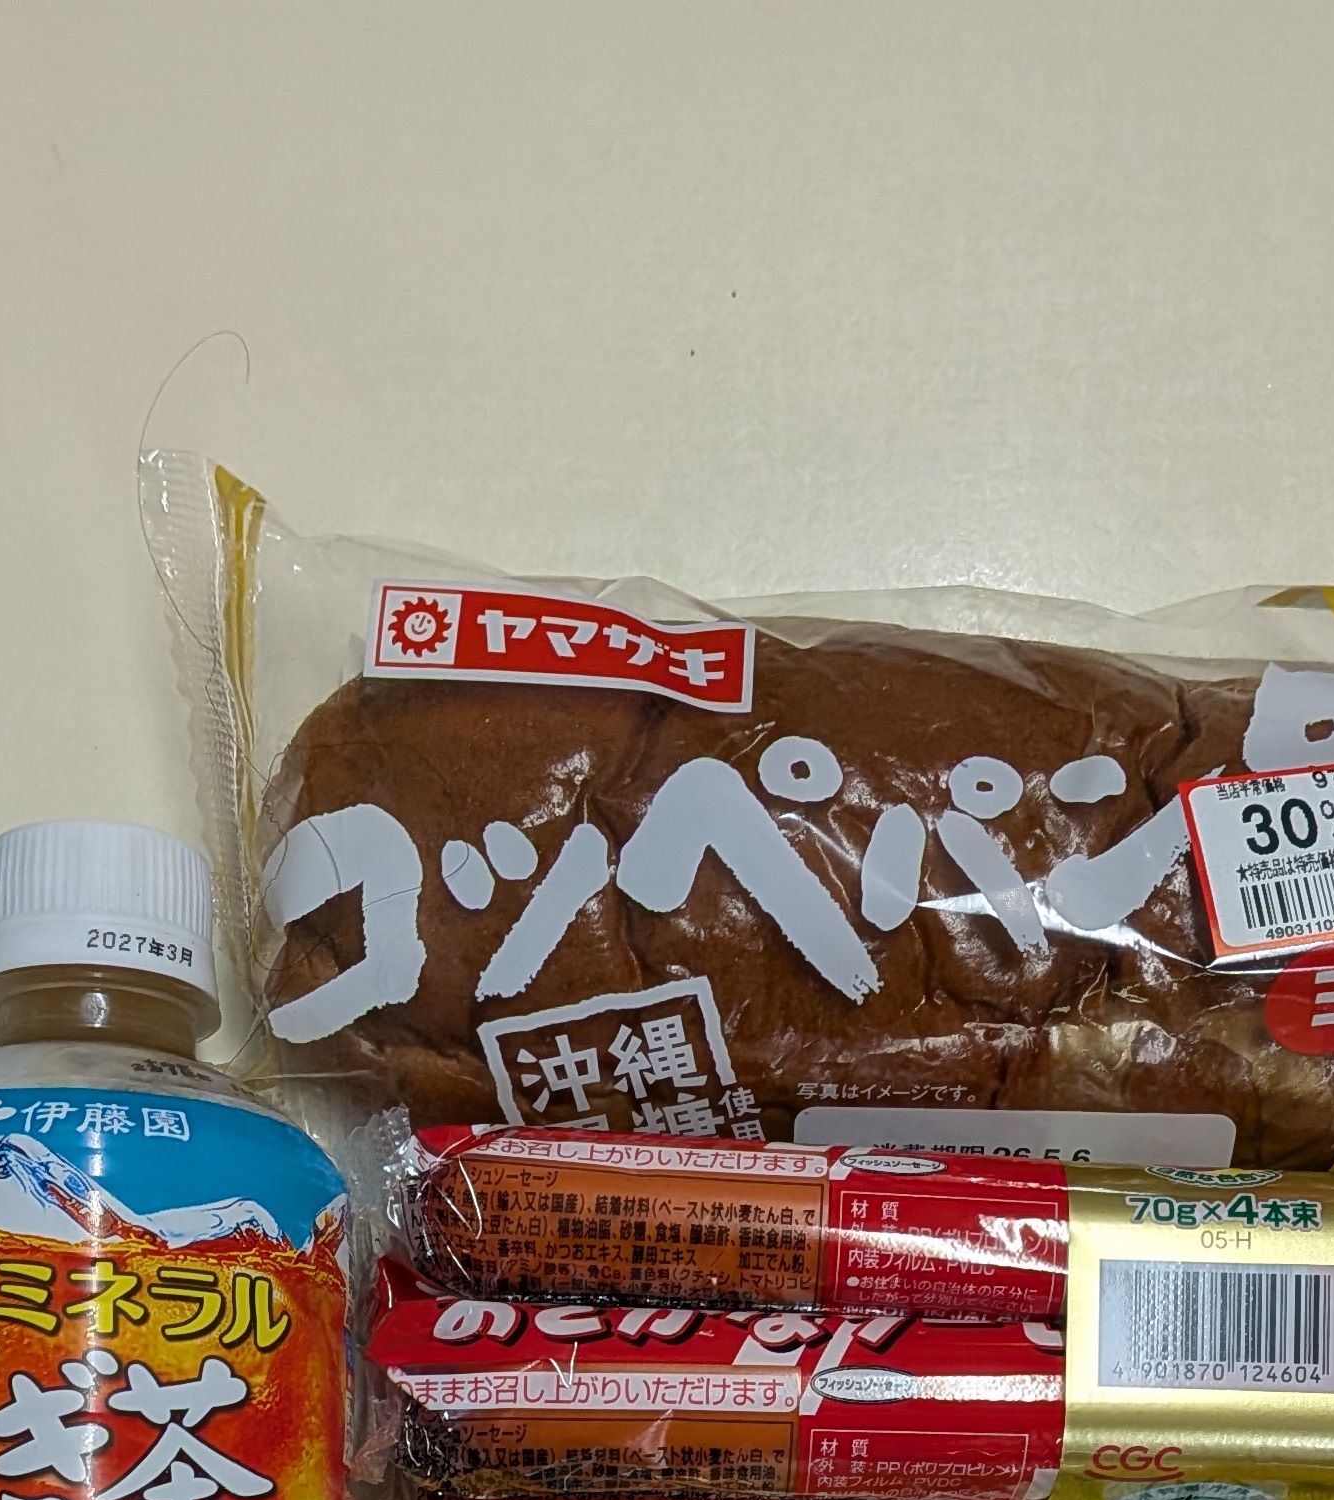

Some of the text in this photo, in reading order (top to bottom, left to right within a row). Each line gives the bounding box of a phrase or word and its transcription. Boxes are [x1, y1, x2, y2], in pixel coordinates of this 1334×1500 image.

[477, 609, 726, 687] ヤマザキ
[263, 735, 1227, 1044] コッペパン
[85, 929, 194, 967] 2027年3月
[516, 1014, 708, 1113] 沖縄
[797, 1081, 977, 1104] 写真はイメージです。
[19, 1099, 191, 1142] 伊藤園
[1200, 1230, 1252, 1250] 05-H
[1140, 1362, 1226, 1381] 901870
[1238, 1365, 1321, 1384] 124604
[1091, 1444, 1183, 1472] CGC
